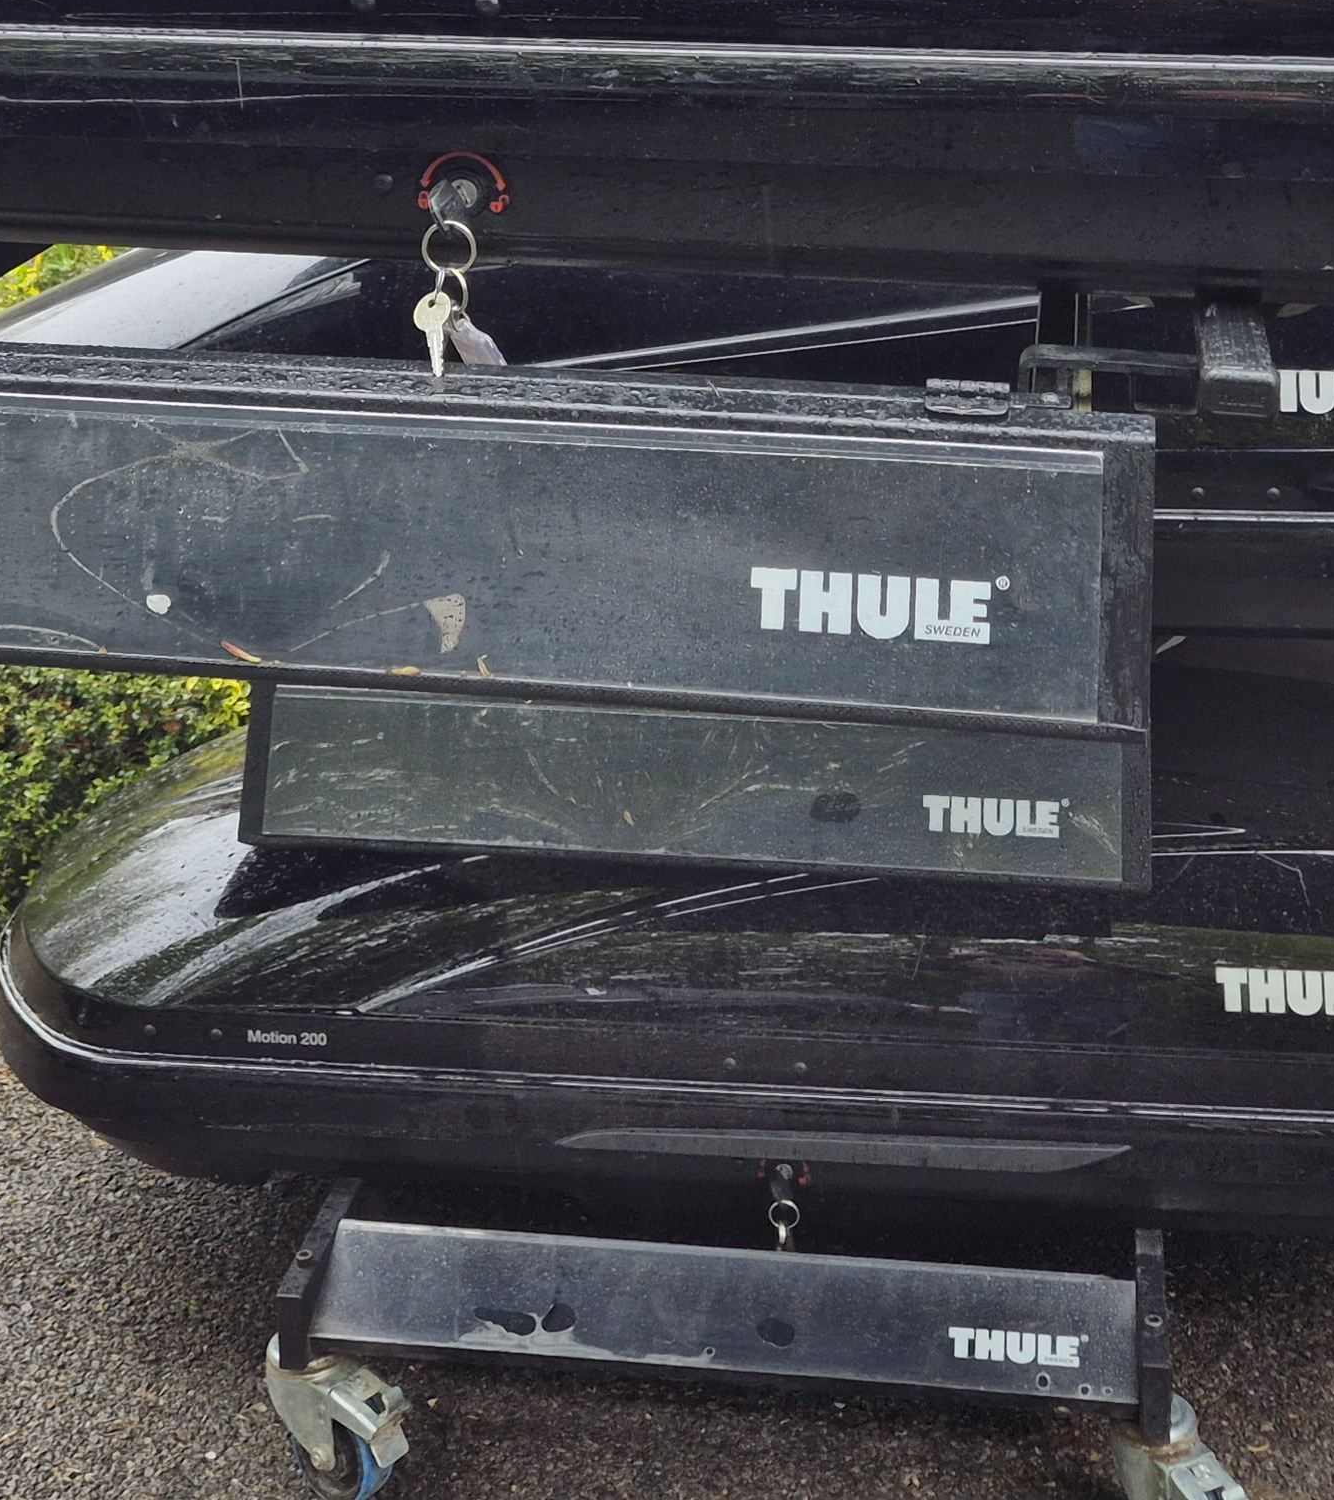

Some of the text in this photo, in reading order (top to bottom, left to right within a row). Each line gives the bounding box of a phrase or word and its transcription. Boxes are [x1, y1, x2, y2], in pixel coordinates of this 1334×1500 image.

[924, 624, 981, 638] SWEDEN
[247, 1029, 328, 1046] Motion 200
